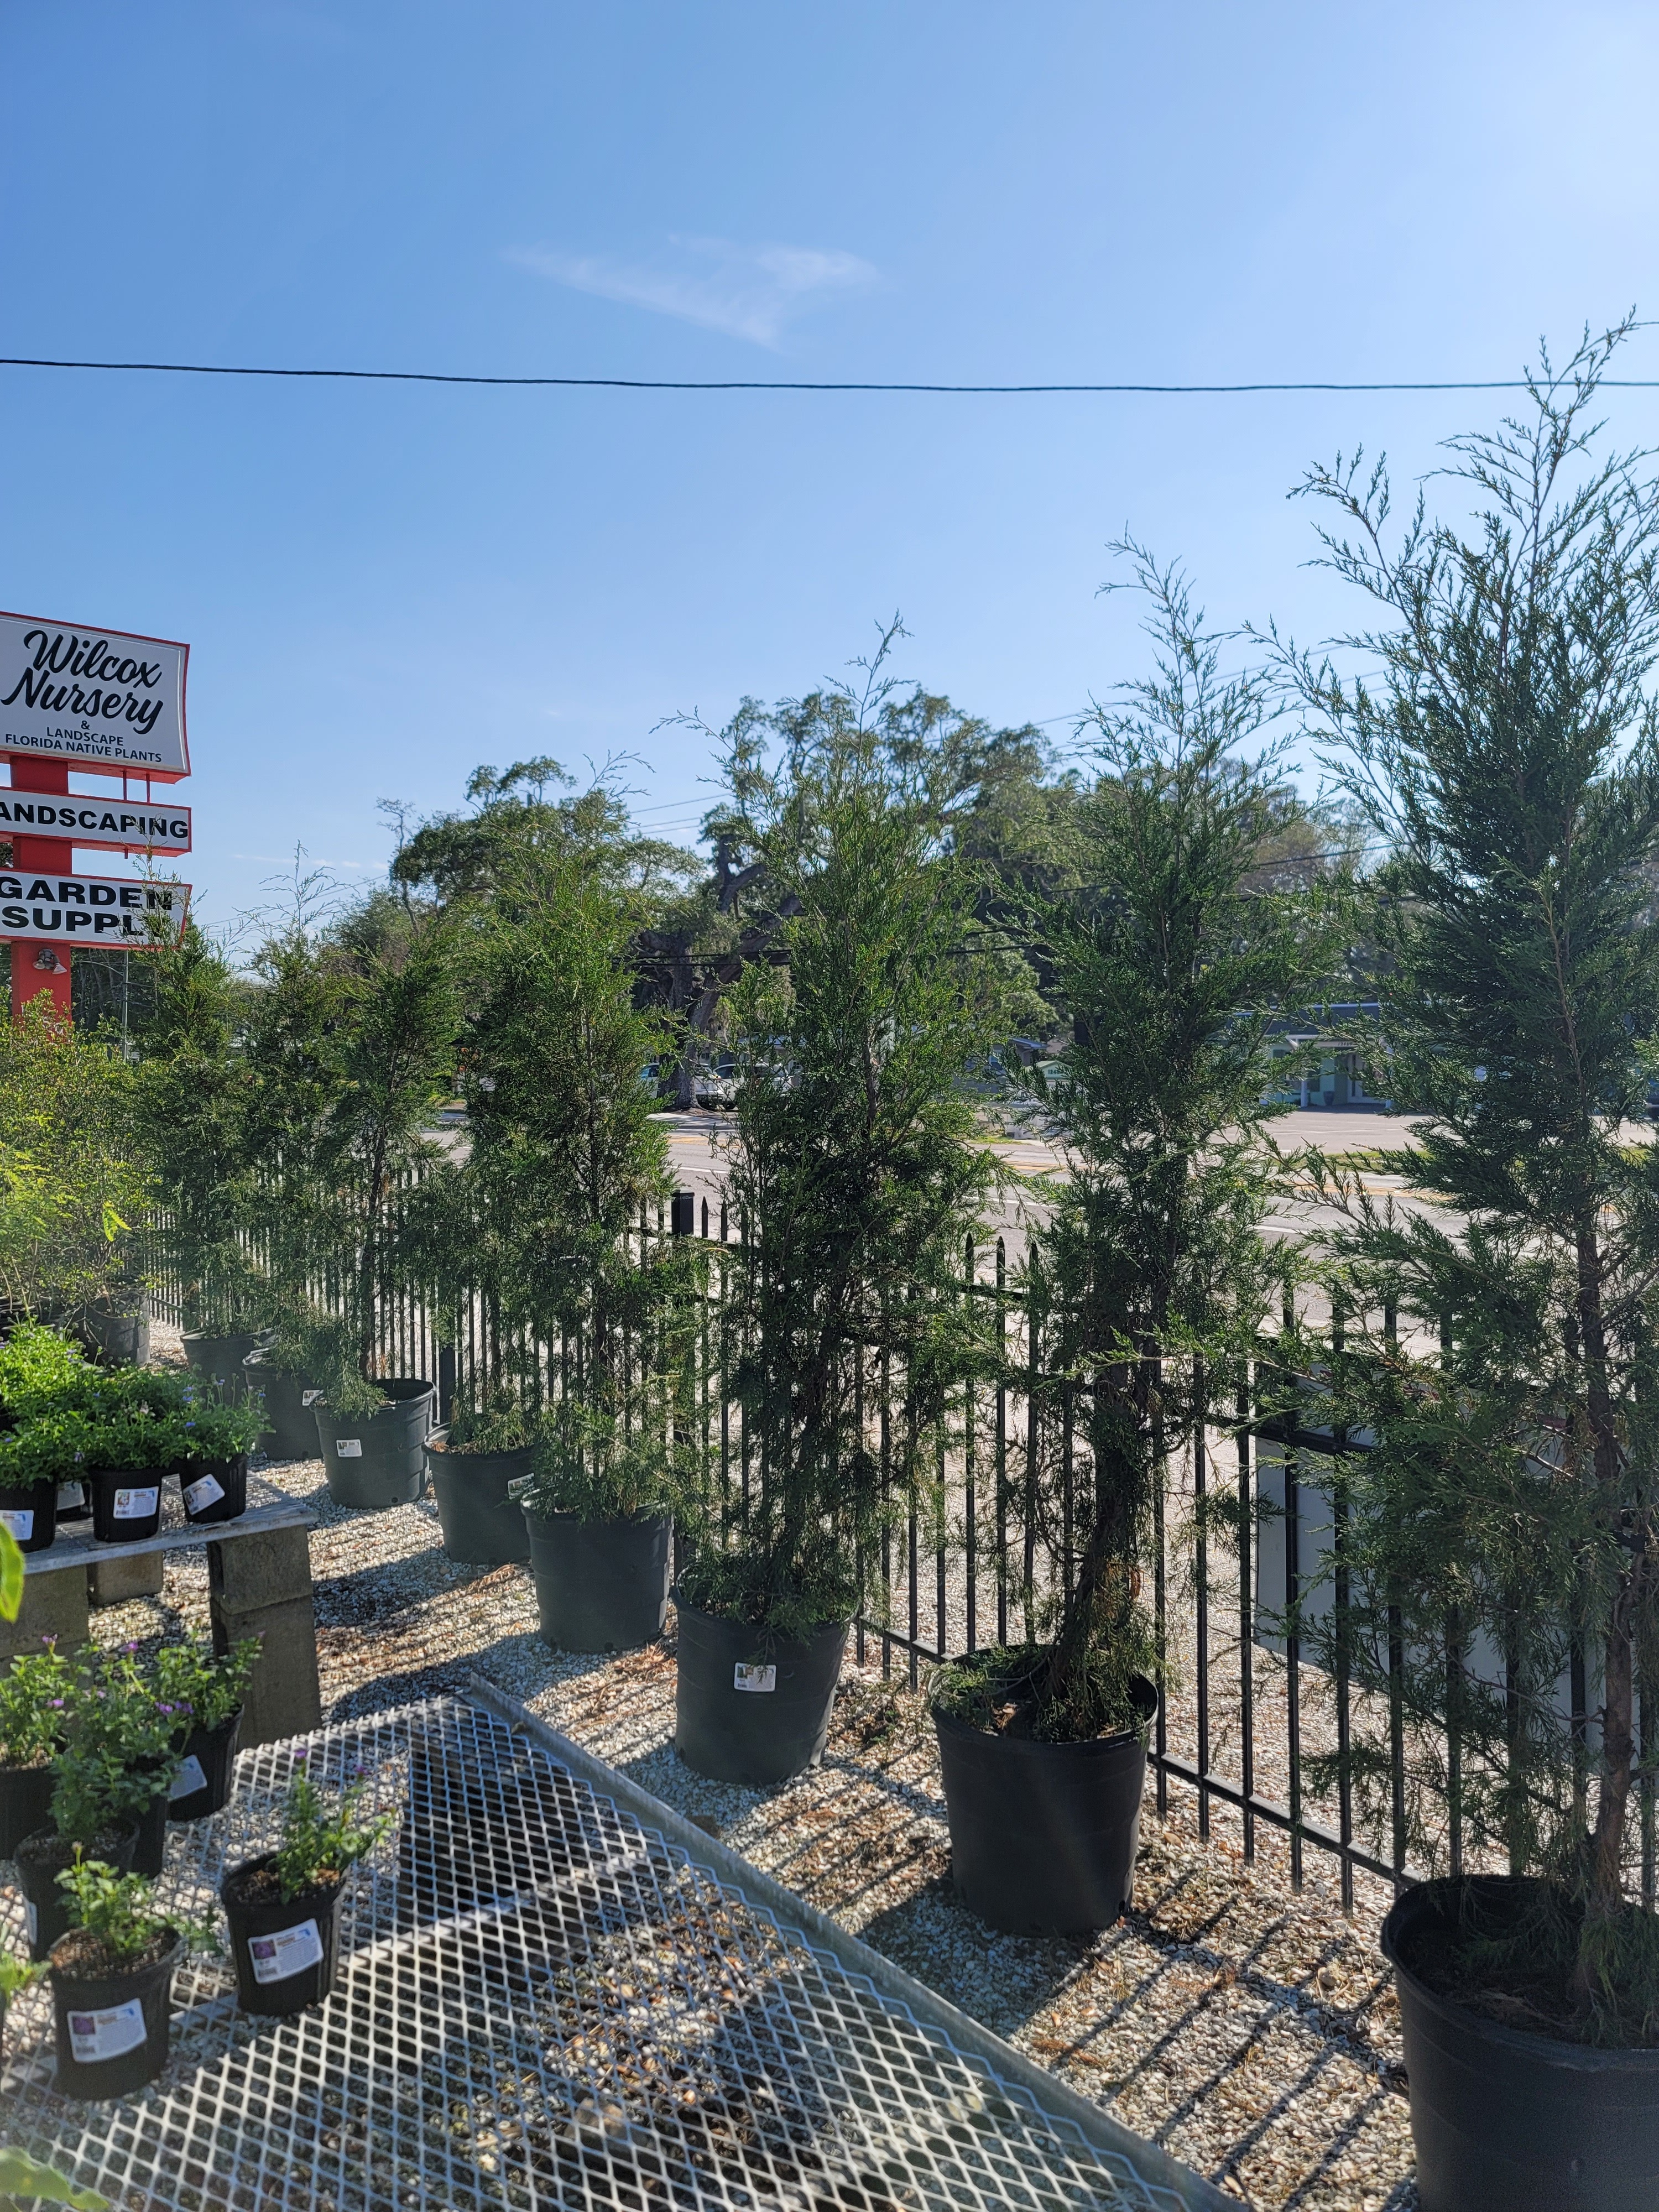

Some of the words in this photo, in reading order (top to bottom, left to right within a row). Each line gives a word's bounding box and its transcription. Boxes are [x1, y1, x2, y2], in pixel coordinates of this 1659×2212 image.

[24, 630, 162, 688] Wilcox
[0, 667, 163, 734] Nursery
[47, 727, 124, 746] LANDSCAPE
[81, 720, 90, 730] &
[5, 733, 62, 750] FLORIDA
[66, 742, 112, 757] NATIVE
[114, 748, 162, 763] PLANTS
[0, 876, 172, 911] GARDEN
[2, 906, 166, 937] SUPPL
